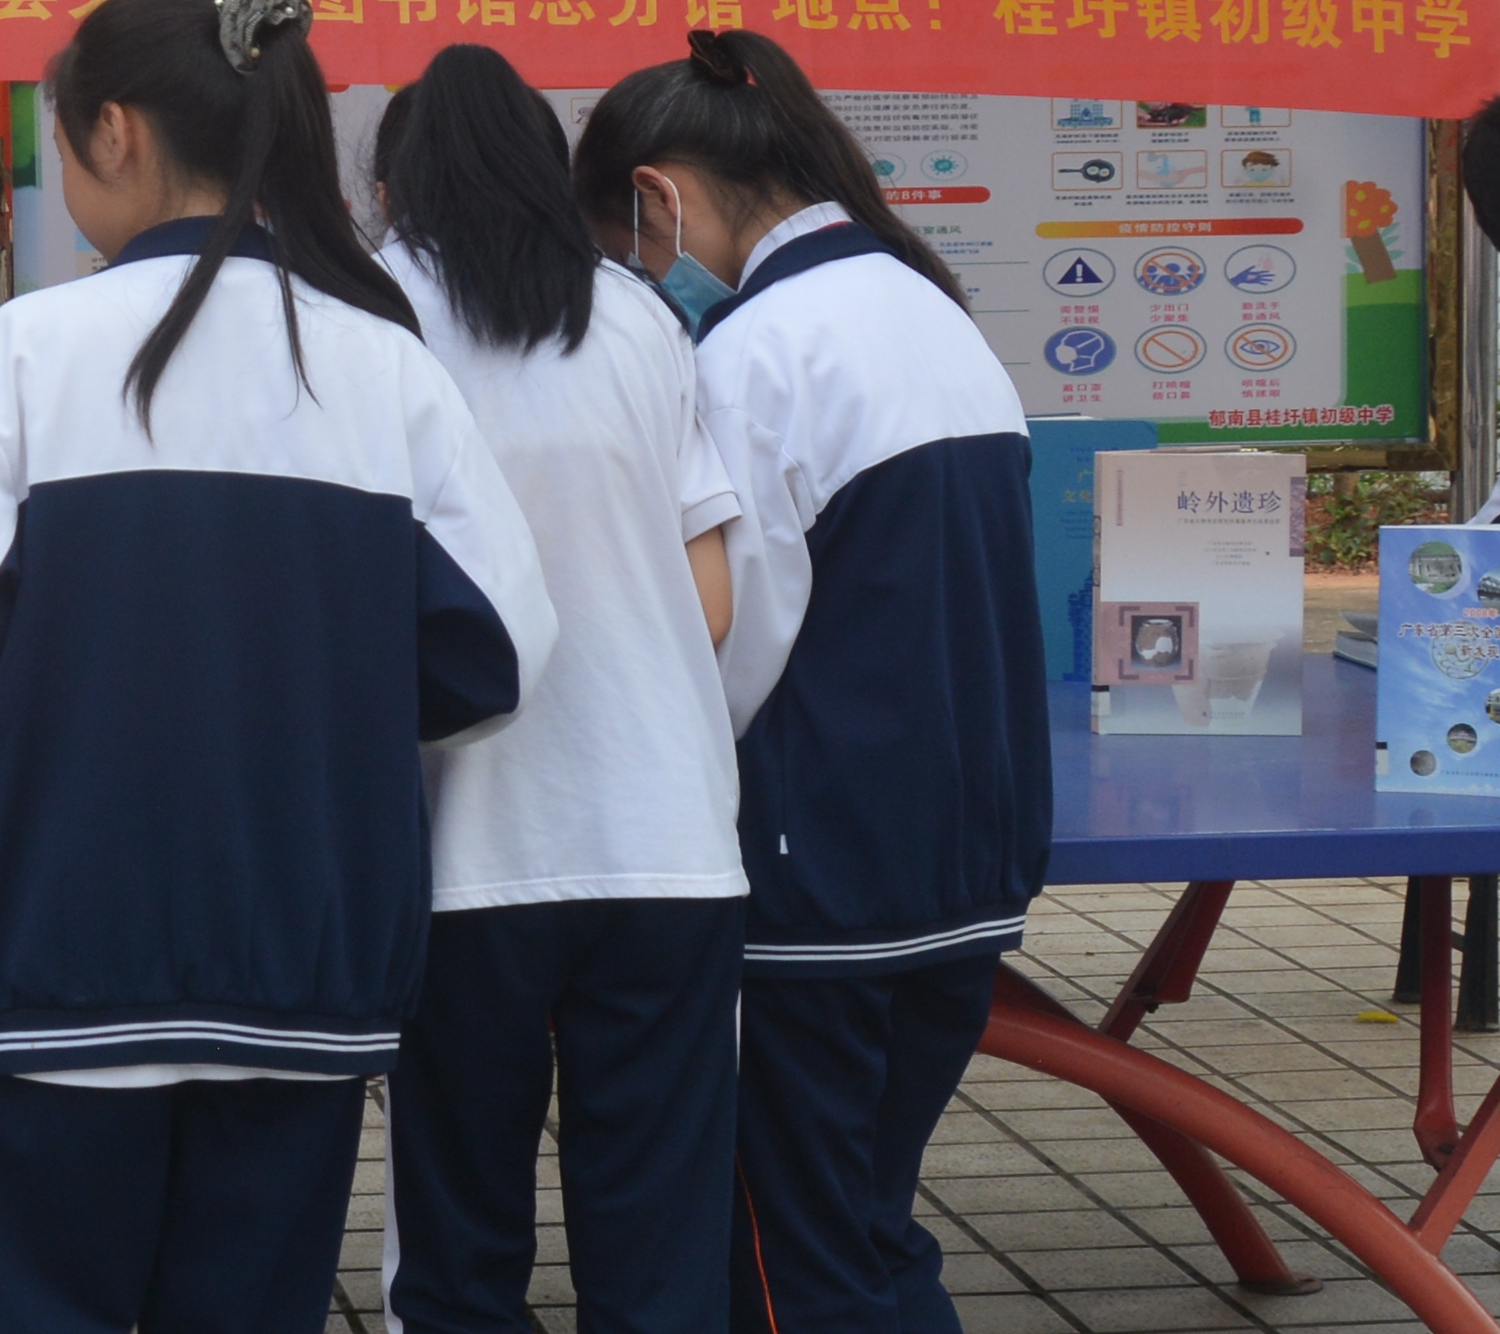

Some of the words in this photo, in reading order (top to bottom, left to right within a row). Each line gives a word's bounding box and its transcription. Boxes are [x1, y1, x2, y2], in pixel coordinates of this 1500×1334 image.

[1118, 220, 1213, 234] 疫情防控守则
[1209, 405, 1394, 428] 郁南县桂圩镇初级中学
[1176, 489, 1283, 515] 岭外遗珍
[1459, 643, 1500, 660] 新发现
